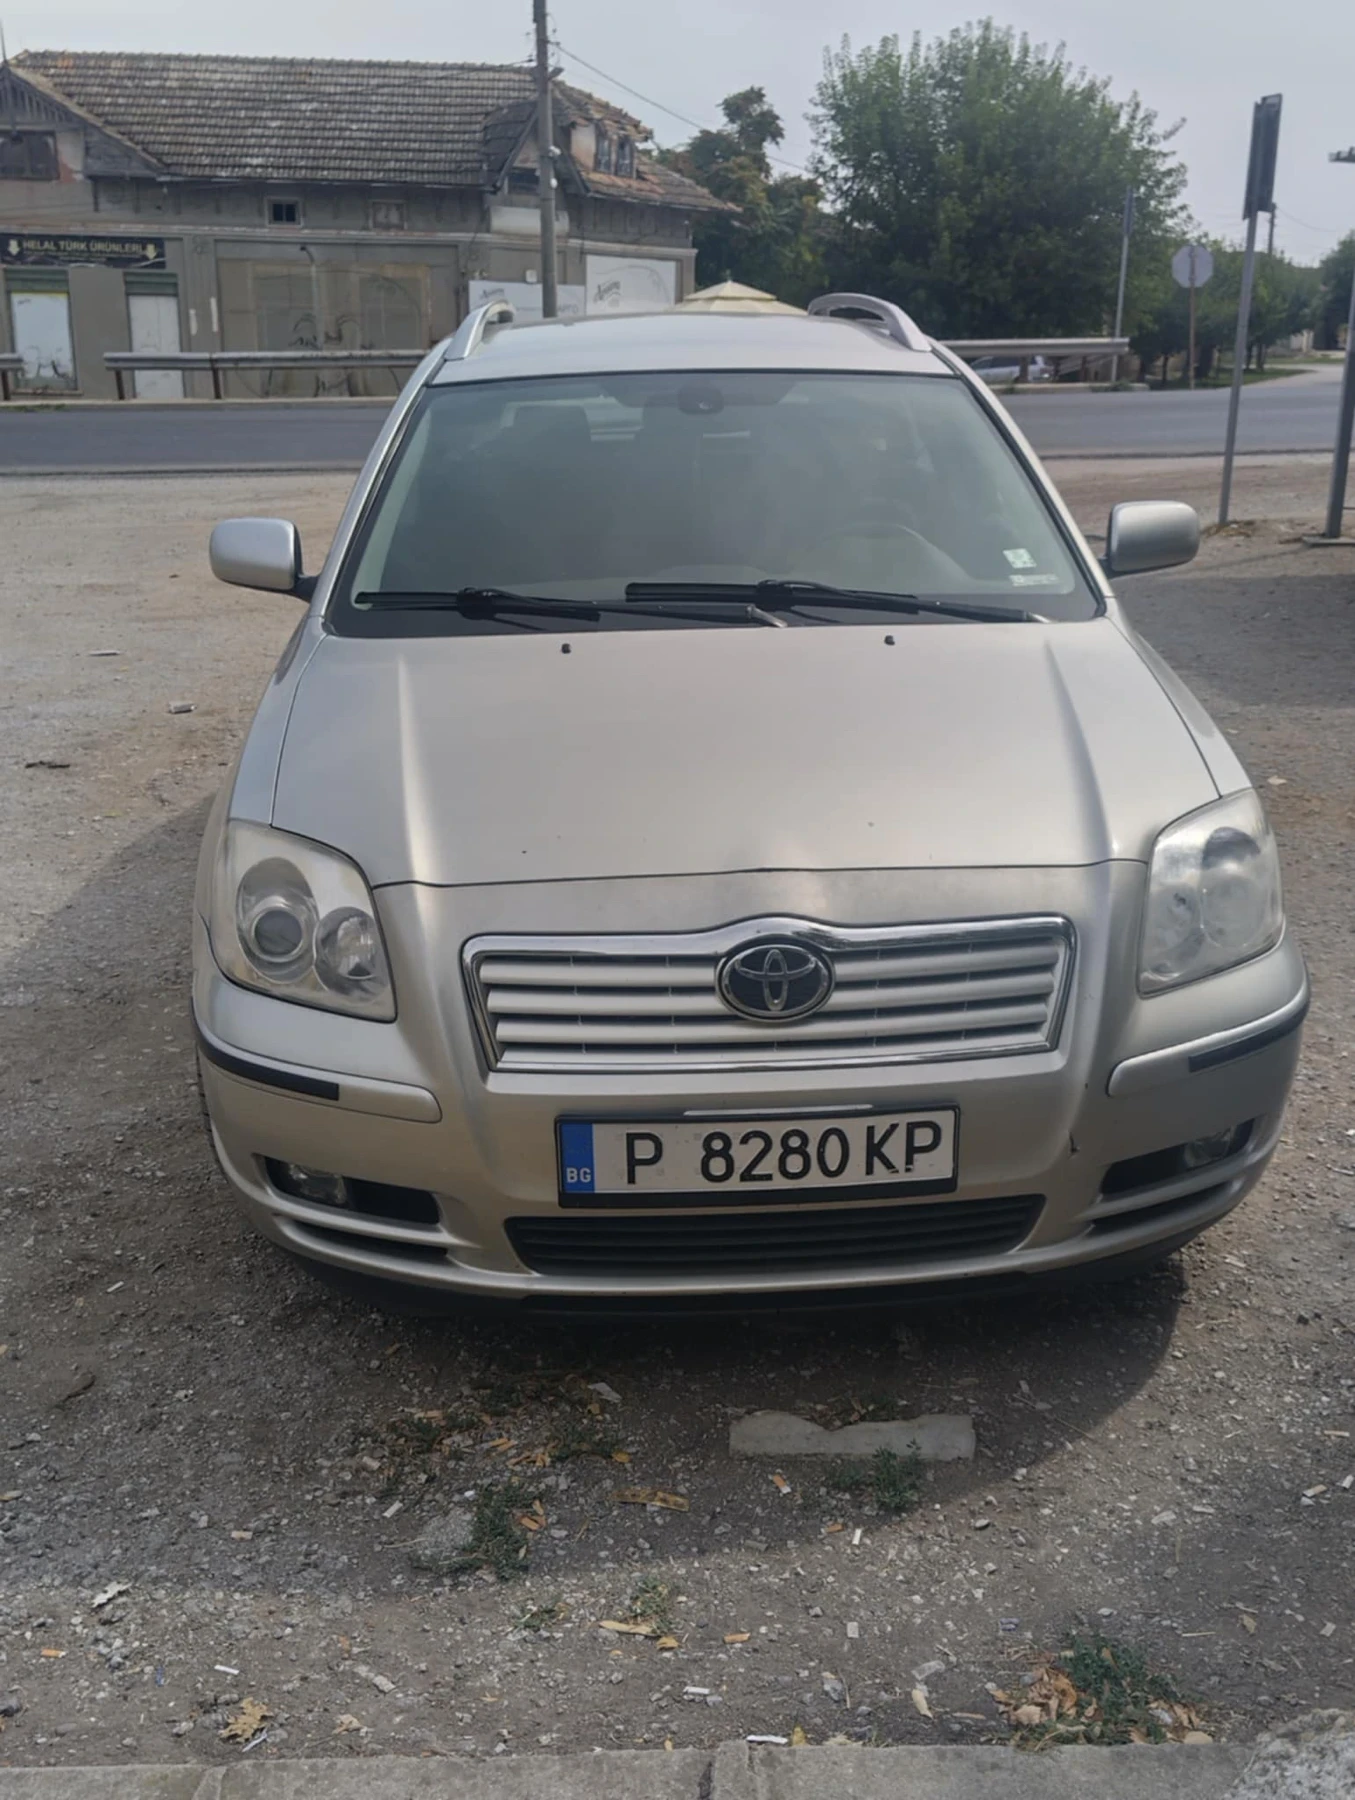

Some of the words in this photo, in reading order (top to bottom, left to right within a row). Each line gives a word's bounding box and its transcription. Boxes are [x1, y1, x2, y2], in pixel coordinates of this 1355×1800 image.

[23, 240, 57, 250] HELAL
[59, 239, 88, 251] TÜRK
[625, 1131, 664, 1185] P
[701, 1127, 851, 1184] 8280
[864, 1120, 942, 1176] KP
[566, 1167, 592, 1184] BG
